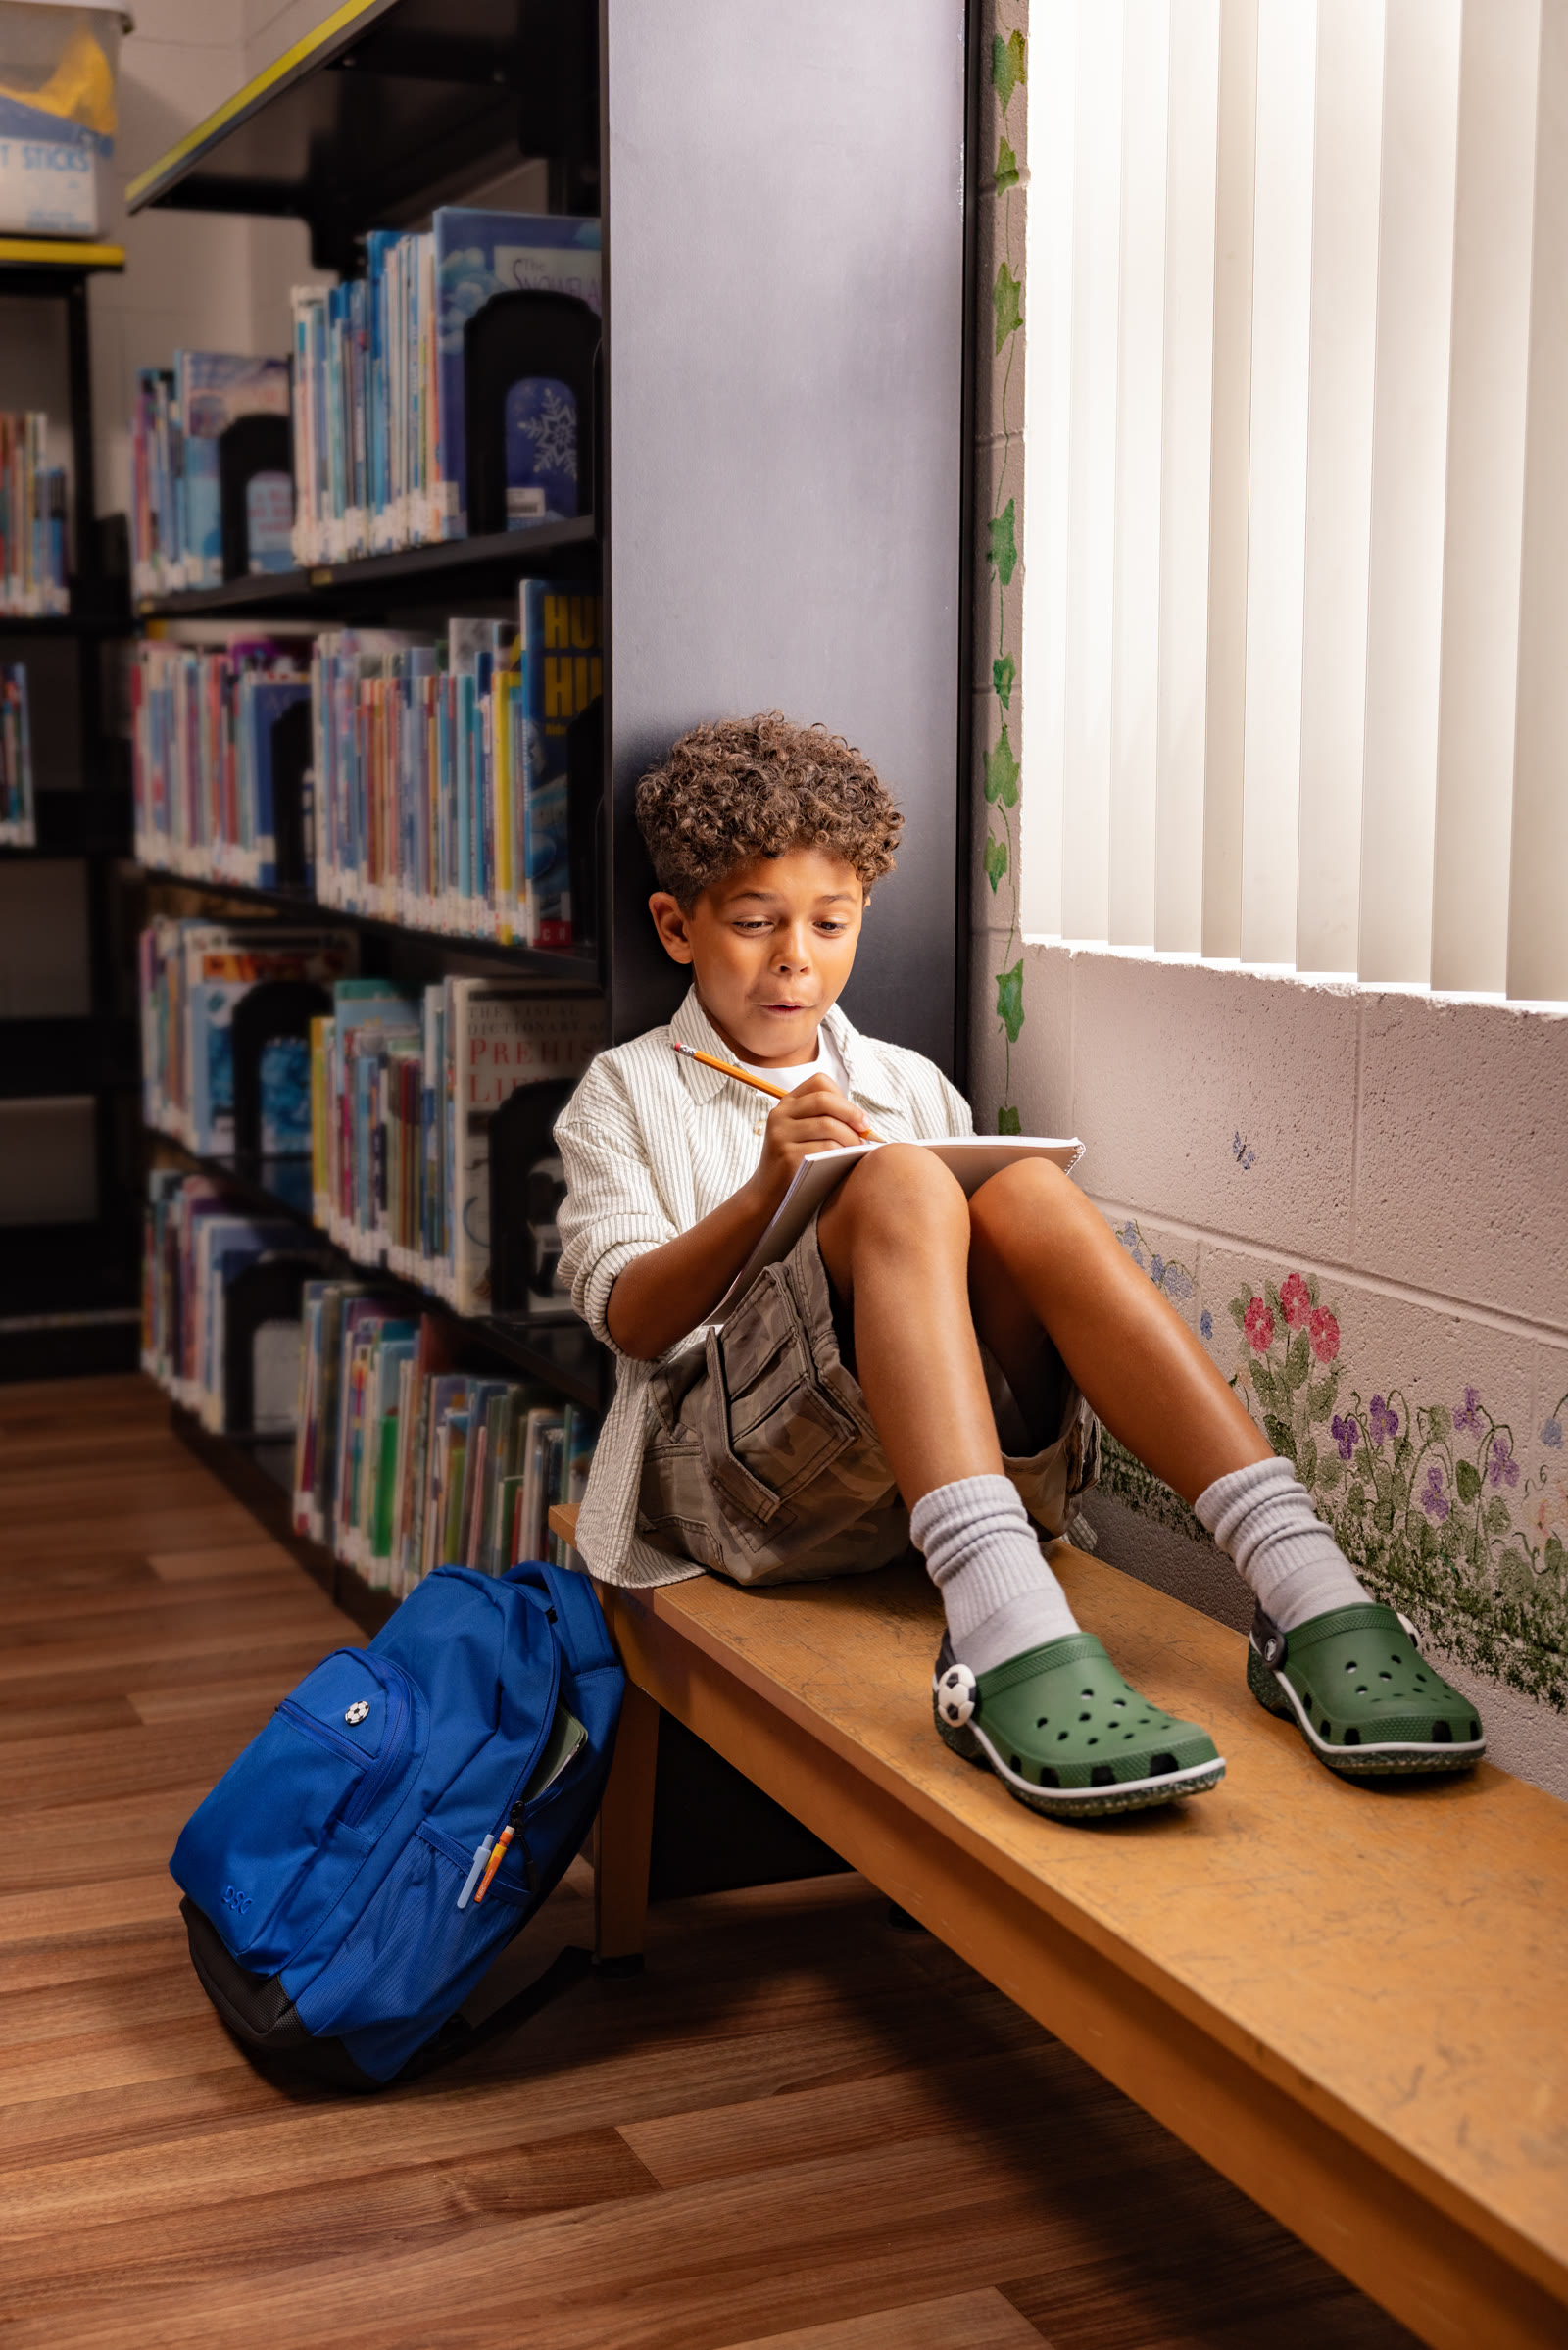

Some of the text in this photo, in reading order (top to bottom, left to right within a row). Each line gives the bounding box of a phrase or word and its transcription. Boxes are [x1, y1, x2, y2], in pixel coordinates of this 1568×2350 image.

[23, 146, 88, 171] STICKS
[544, 595, 603, 649] HU
[469, 1005, 502, 1019] THE
[468, 1021, 580, 1035] DICTIONARY
